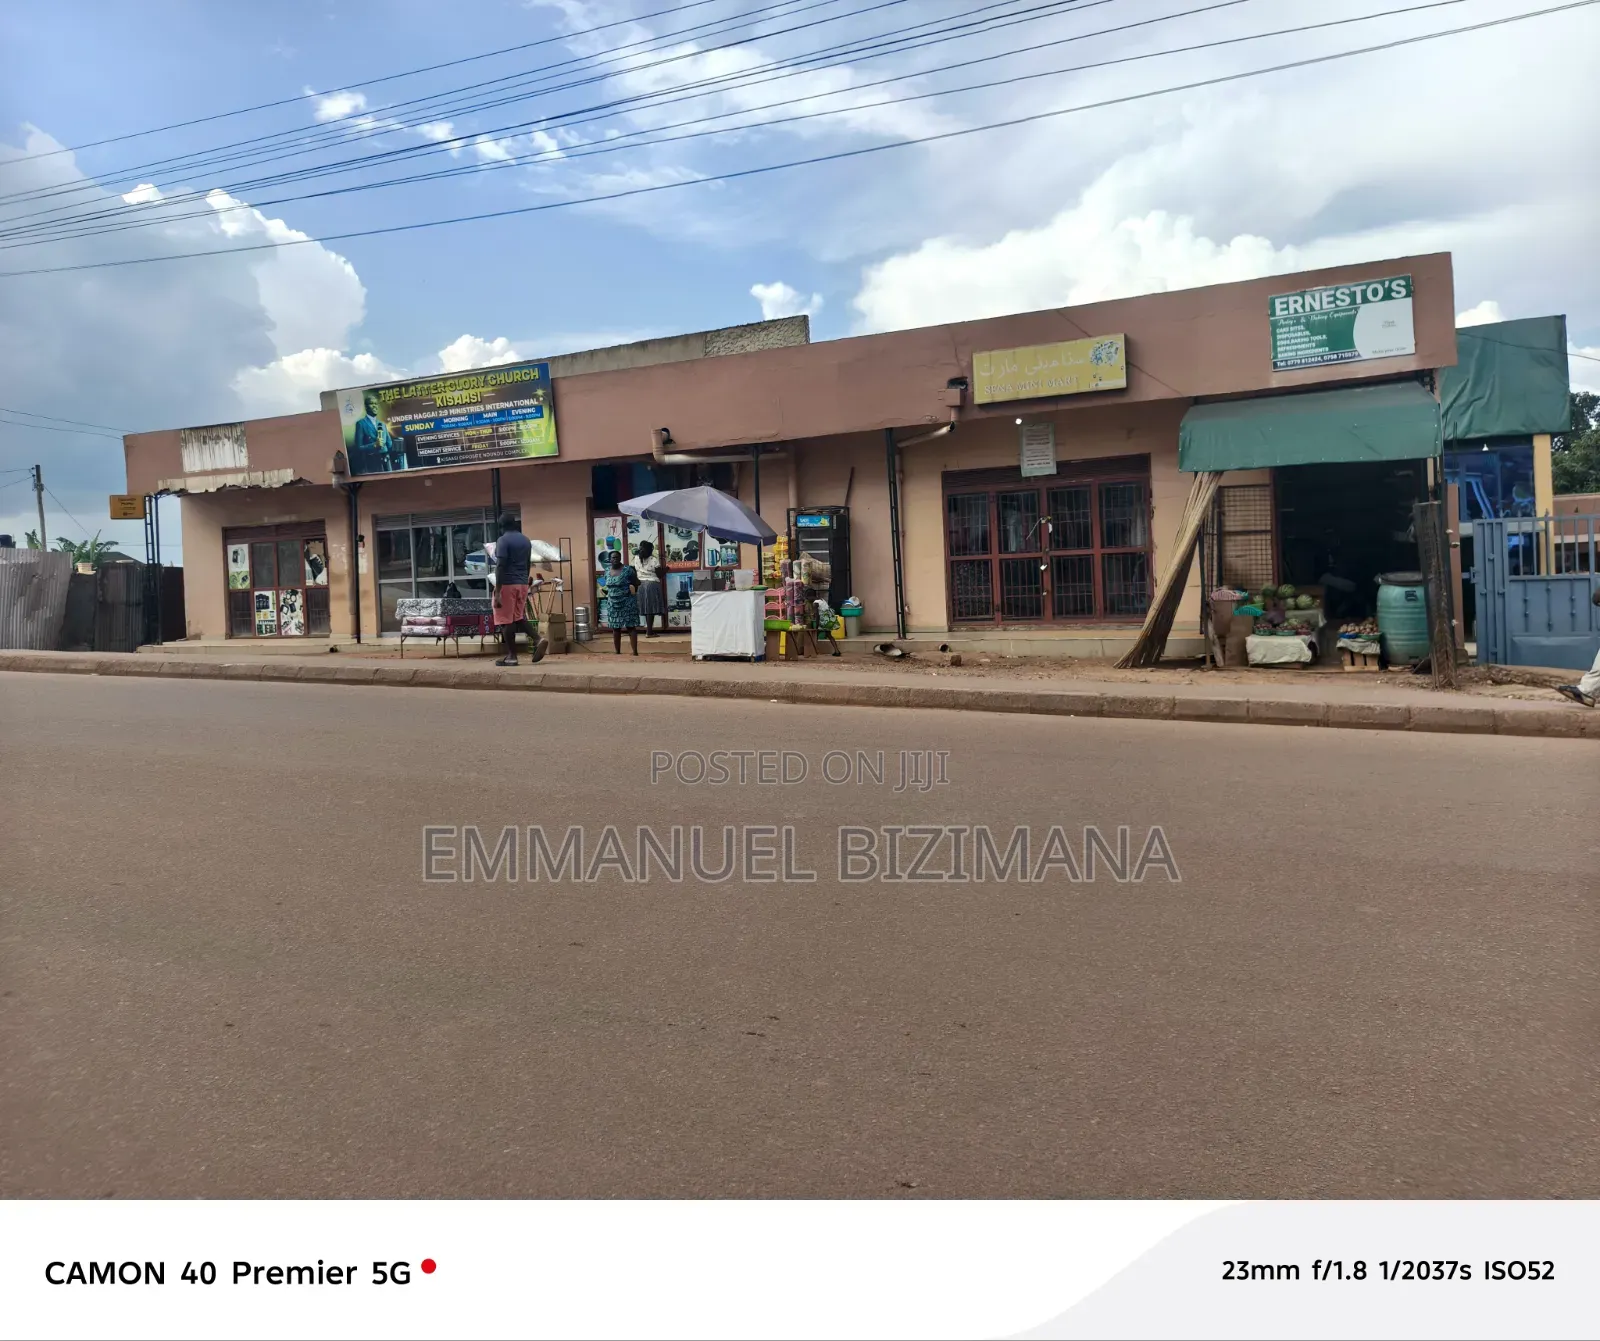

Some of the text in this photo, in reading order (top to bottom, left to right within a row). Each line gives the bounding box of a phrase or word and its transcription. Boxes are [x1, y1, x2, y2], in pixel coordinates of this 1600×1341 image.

[1274, 279, 1407, 317] ERNESTO'S
[378, 367, 539, 402] THE LATTER GLORY CHURCH
[984, 376, 1078, 395] SENA MINI MART
[435, 391, 481, 408] KISAASI
[413, 411, 438, 420] HAGGAI
[449, 405, 484, 415] MINISTRIES
[485, 398, 539, 410] INTERNATIONAL
[511, 407, 536, 416] EVENING
[405, 422, 435, 432] SUNDAY
[443, 415, 469, 424] MORNING
[417, 432, 460, 442] EVENING SERVICES
